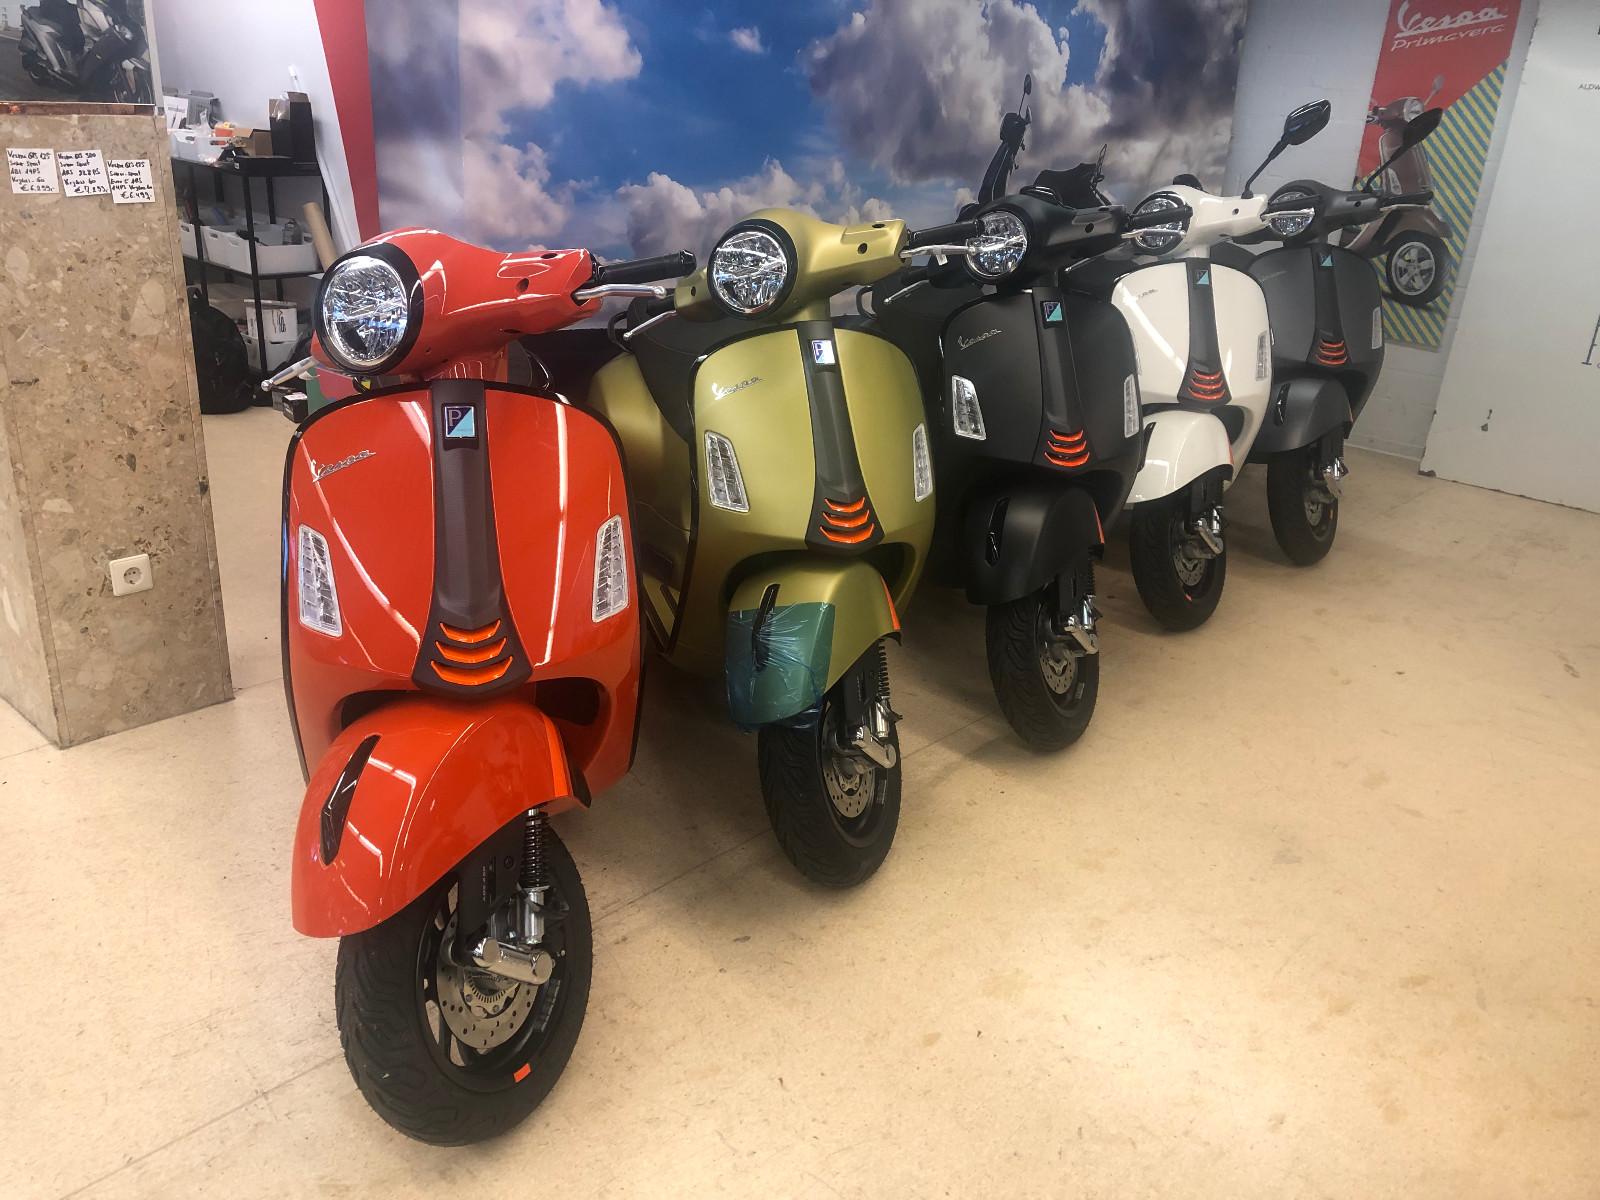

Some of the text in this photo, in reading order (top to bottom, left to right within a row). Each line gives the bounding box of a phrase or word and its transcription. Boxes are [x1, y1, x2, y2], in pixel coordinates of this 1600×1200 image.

[1395, 1, 1509, 38] Vespa
[8, 150, 27, 159] Vespa
[107, 160, 124, 169] Vespa
[957, 328, 1003, 351] Vespa
[711, 376, 767, 401] Vespa
[310, 449, 377, 483] Vespa
